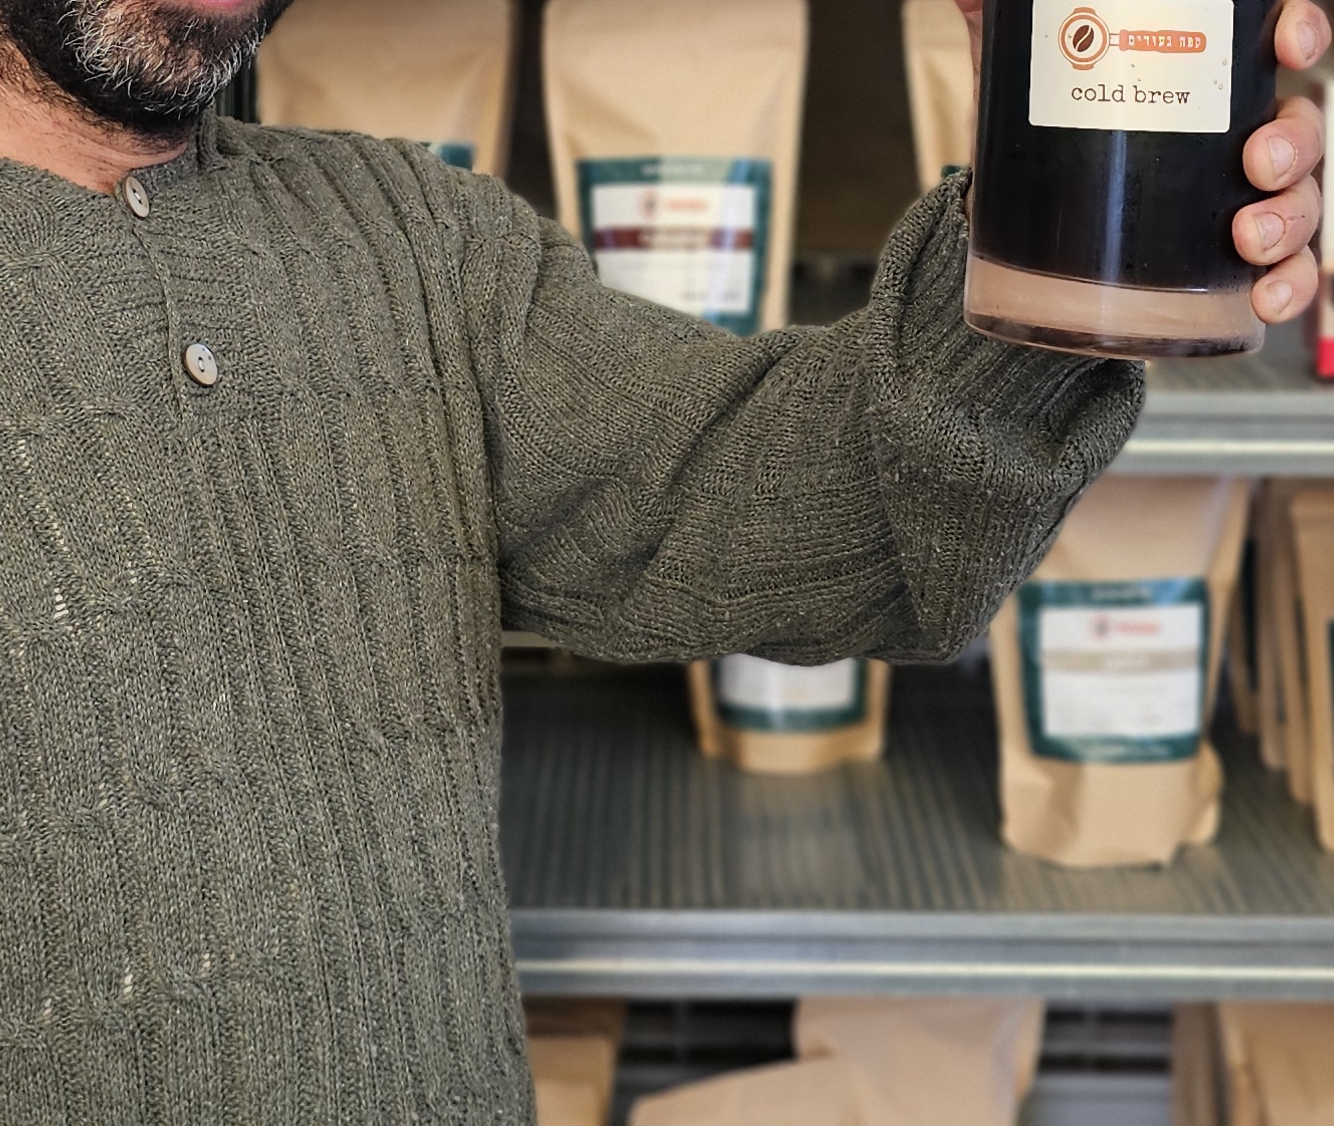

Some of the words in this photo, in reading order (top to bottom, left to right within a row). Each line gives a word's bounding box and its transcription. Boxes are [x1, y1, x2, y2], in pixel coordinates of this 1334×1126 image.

[1179, 36, 1201, 49] קפה
[1071, 83, 1127, 103] cold
[1132, 84, 1191, 104] brew
